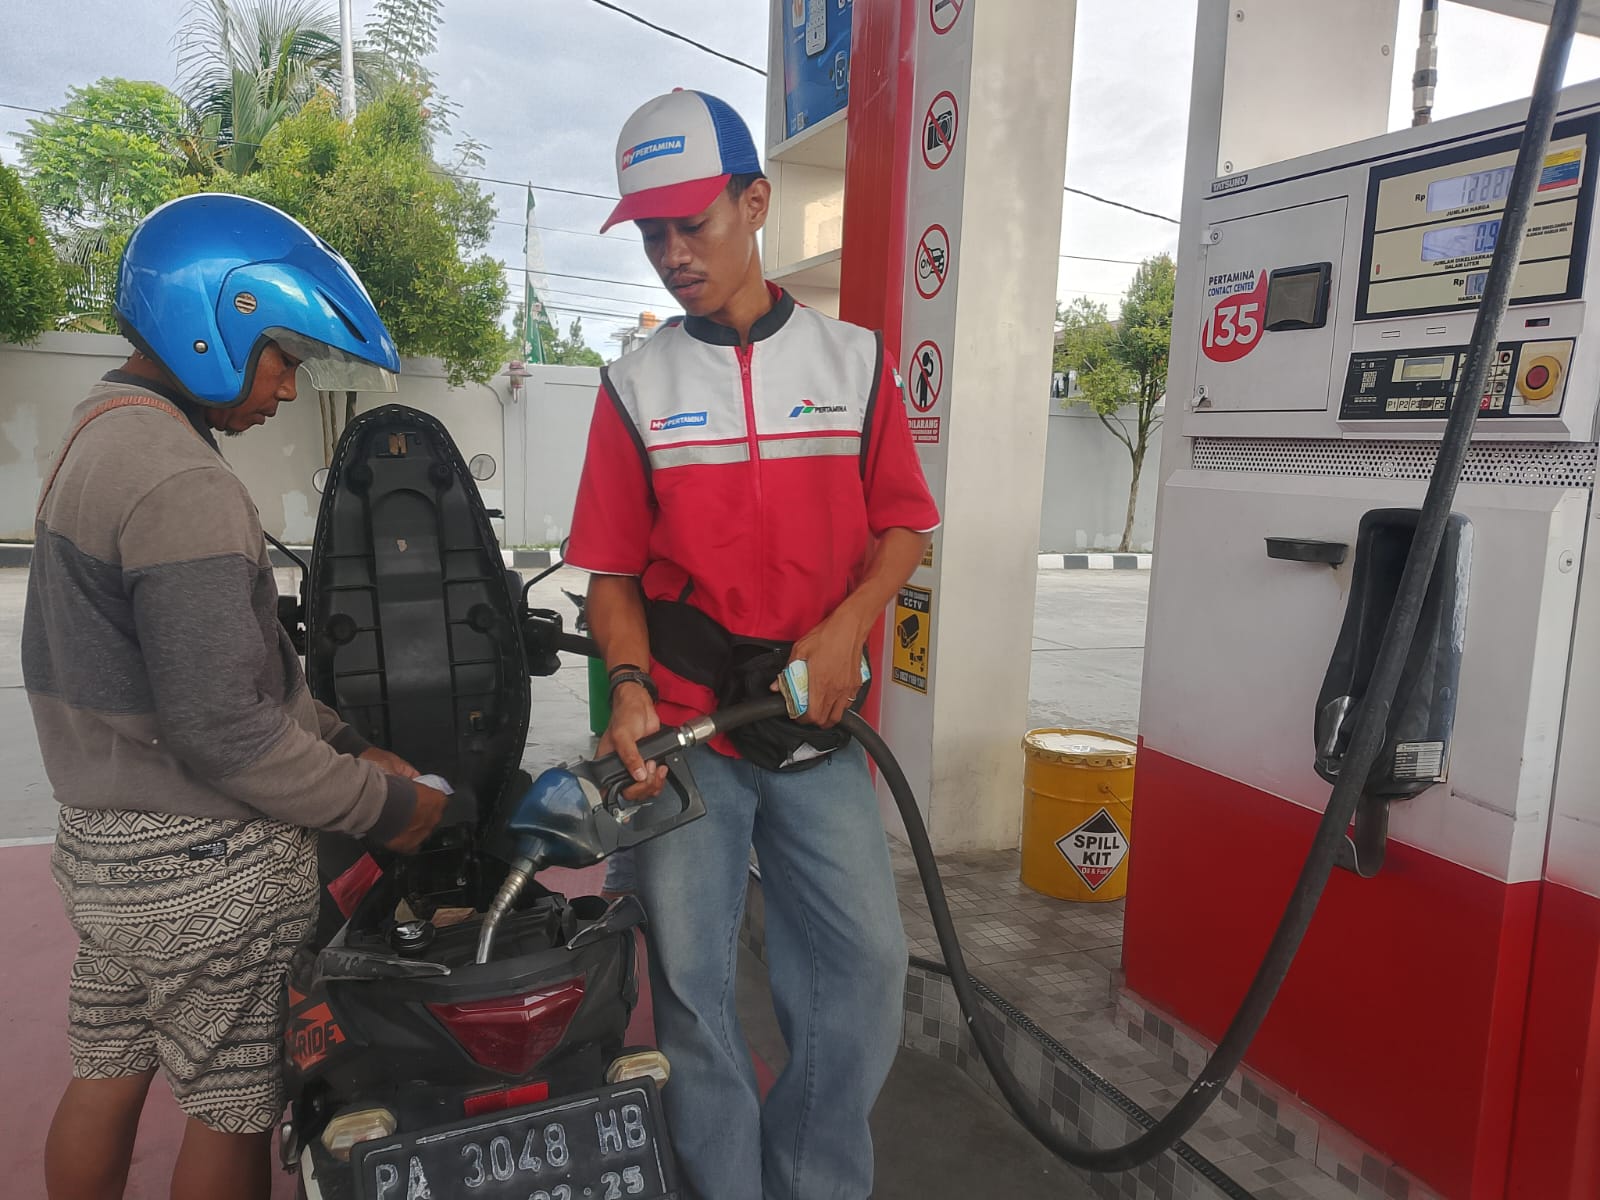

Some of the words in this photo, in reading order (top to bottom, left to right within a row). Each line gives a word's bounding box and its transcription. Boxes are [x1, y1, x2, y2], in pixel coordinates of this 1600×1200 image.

[1415, 193, 1426, 202] Rp
[1209, 270, 1254, 285] PERTAMINA
[1453, 278, 1464, 287] Rp
[1208, 286, 1232, 296] CONTACT
[1234, 282, 1254, 292] CENTER
[1206, 302, 1259, 348] 135
[815, 405, 848, 414] PERTAMINA
[904, 597, 922, 610] CCTV
[1073, 834, 1120, 850] SPILL
[1082, 851, 1111, 866] KIT
[375, 1155, 432, 1200] PA
[461, 1122, 569, 1188] 3048
[594, 1104, 647, 1155] HB
